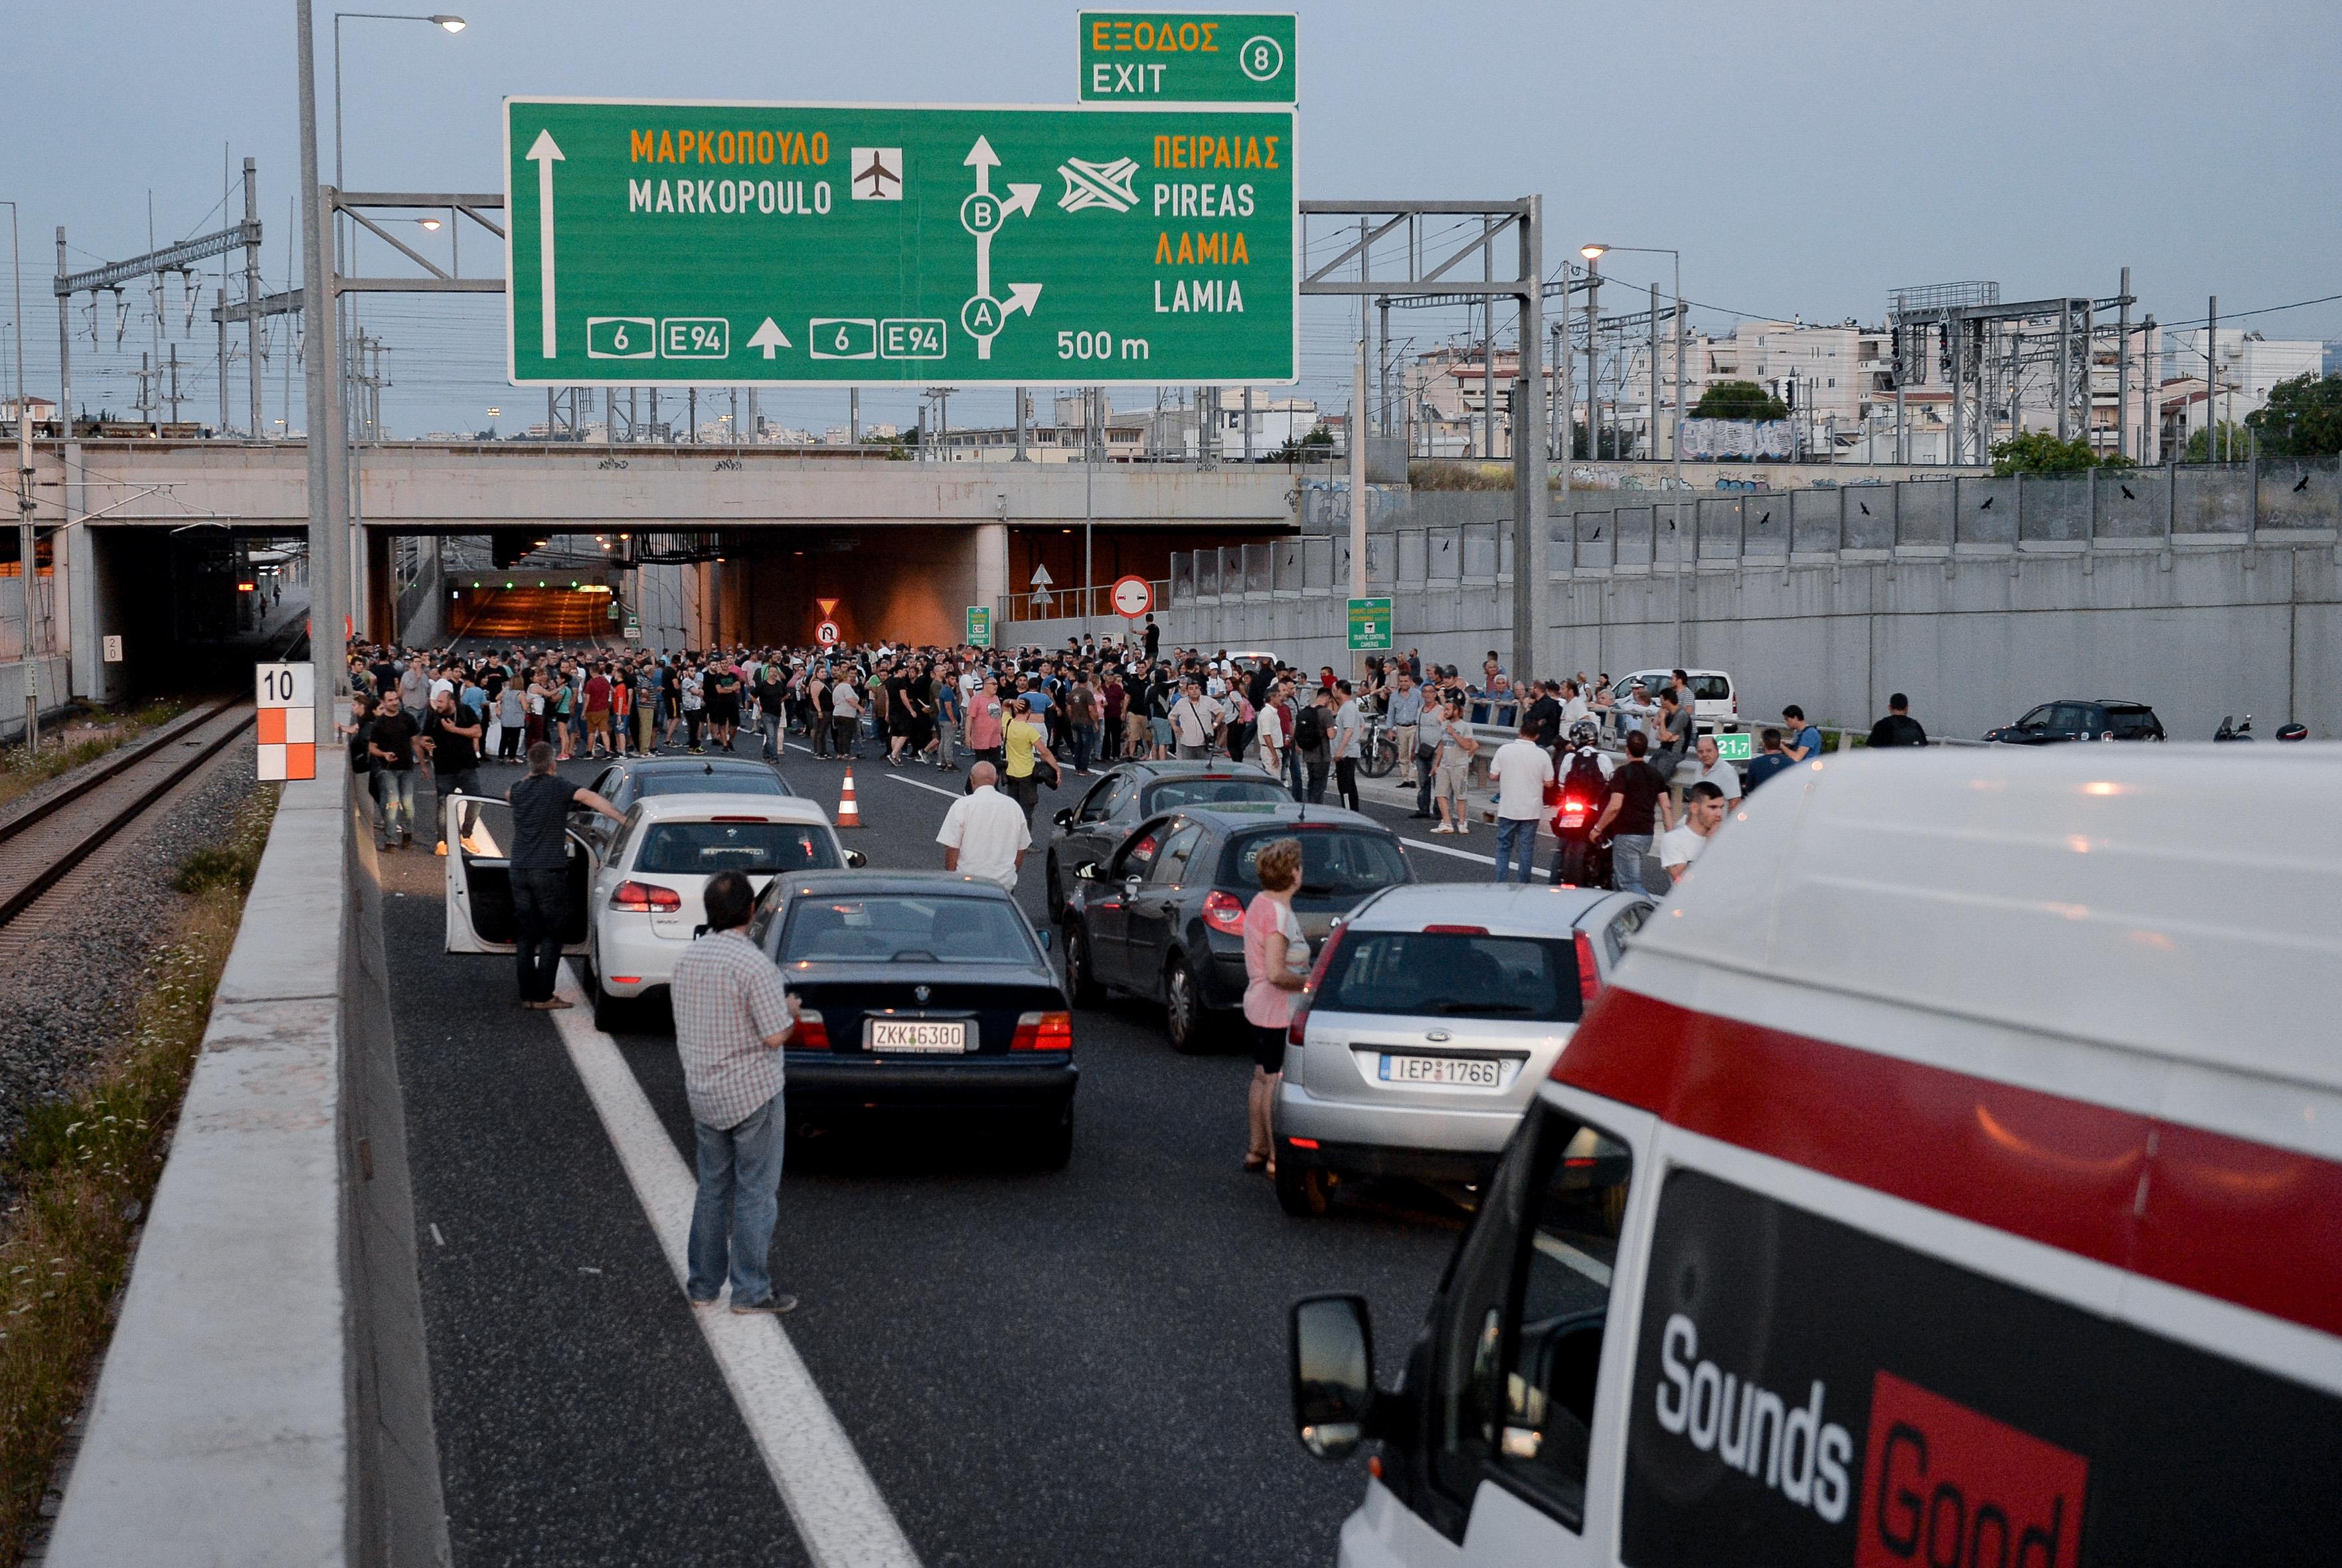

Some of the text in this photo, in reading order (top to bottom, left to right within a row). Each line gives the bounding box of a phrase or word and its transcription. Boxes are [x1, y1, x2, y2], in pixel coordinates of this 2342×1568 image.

[1092, 22, 1218, 52] ΕΞΟΔΟΣ
[1254, 46, 1270, 71] 8
[1092, 64, 1167, 93] EXIT
[630, 129, 829, 165] ΜΑΡΚΟΠΟΥΛΟ
[1153, 135, 1279, 169] ΠΕΙΡΑΙΑΣ
[629, 179, 832, 214] MARKOPOULO
[1153, 183, 1254, 216] PIREAS
[974, 202, 992, 226] B
[1155, 232, 1250, 265] ΛΑΜΙΑ
[1154, 279, 1244, 313] LAMIA
[973, 303, 993, 327] A
[614, 325, 629, 351] 6
[835, 326, 849, 351] 6
[1057, 331, 1149, 359] 500 m
[264, 670, 293, 701] 10
[1716, 740, 1749, 756] 21,7
[1656, 1313, 1853, 1524] Sounds
